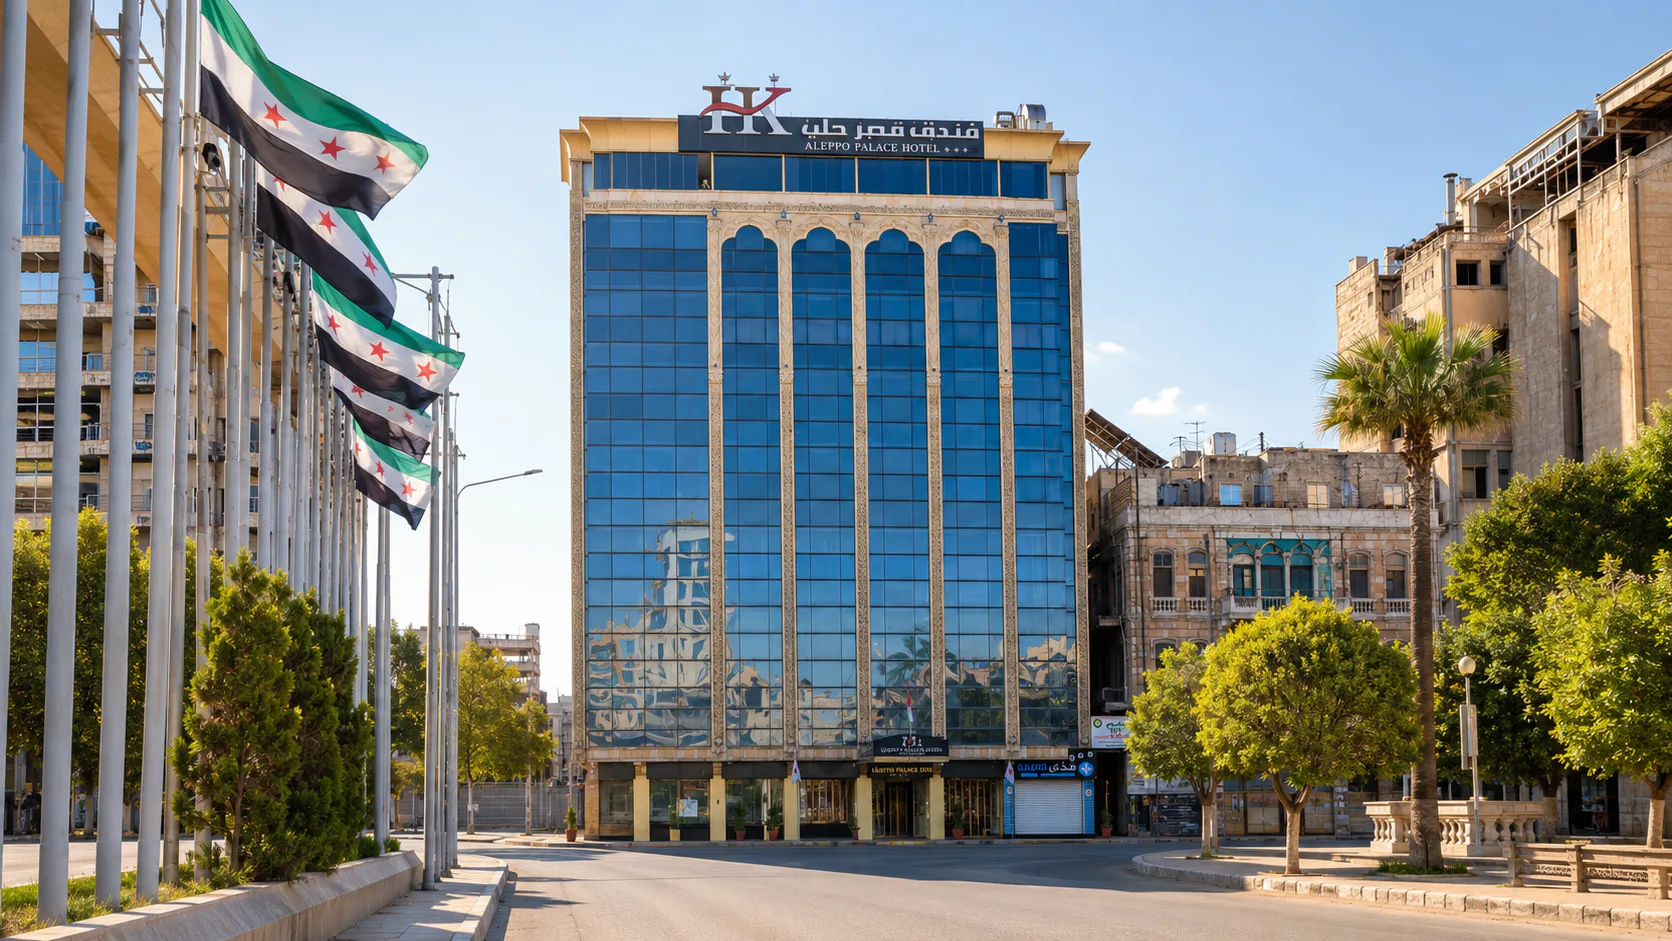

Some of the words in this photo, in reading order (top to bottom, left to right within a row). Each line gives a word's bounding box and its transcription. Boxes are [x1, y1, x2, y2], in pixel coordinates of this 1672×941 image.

[805, 142, 850, 151] ALEPPO
[855, 143, 898, 152] PALACE
[902, 144, 940, 153] HOTEL
